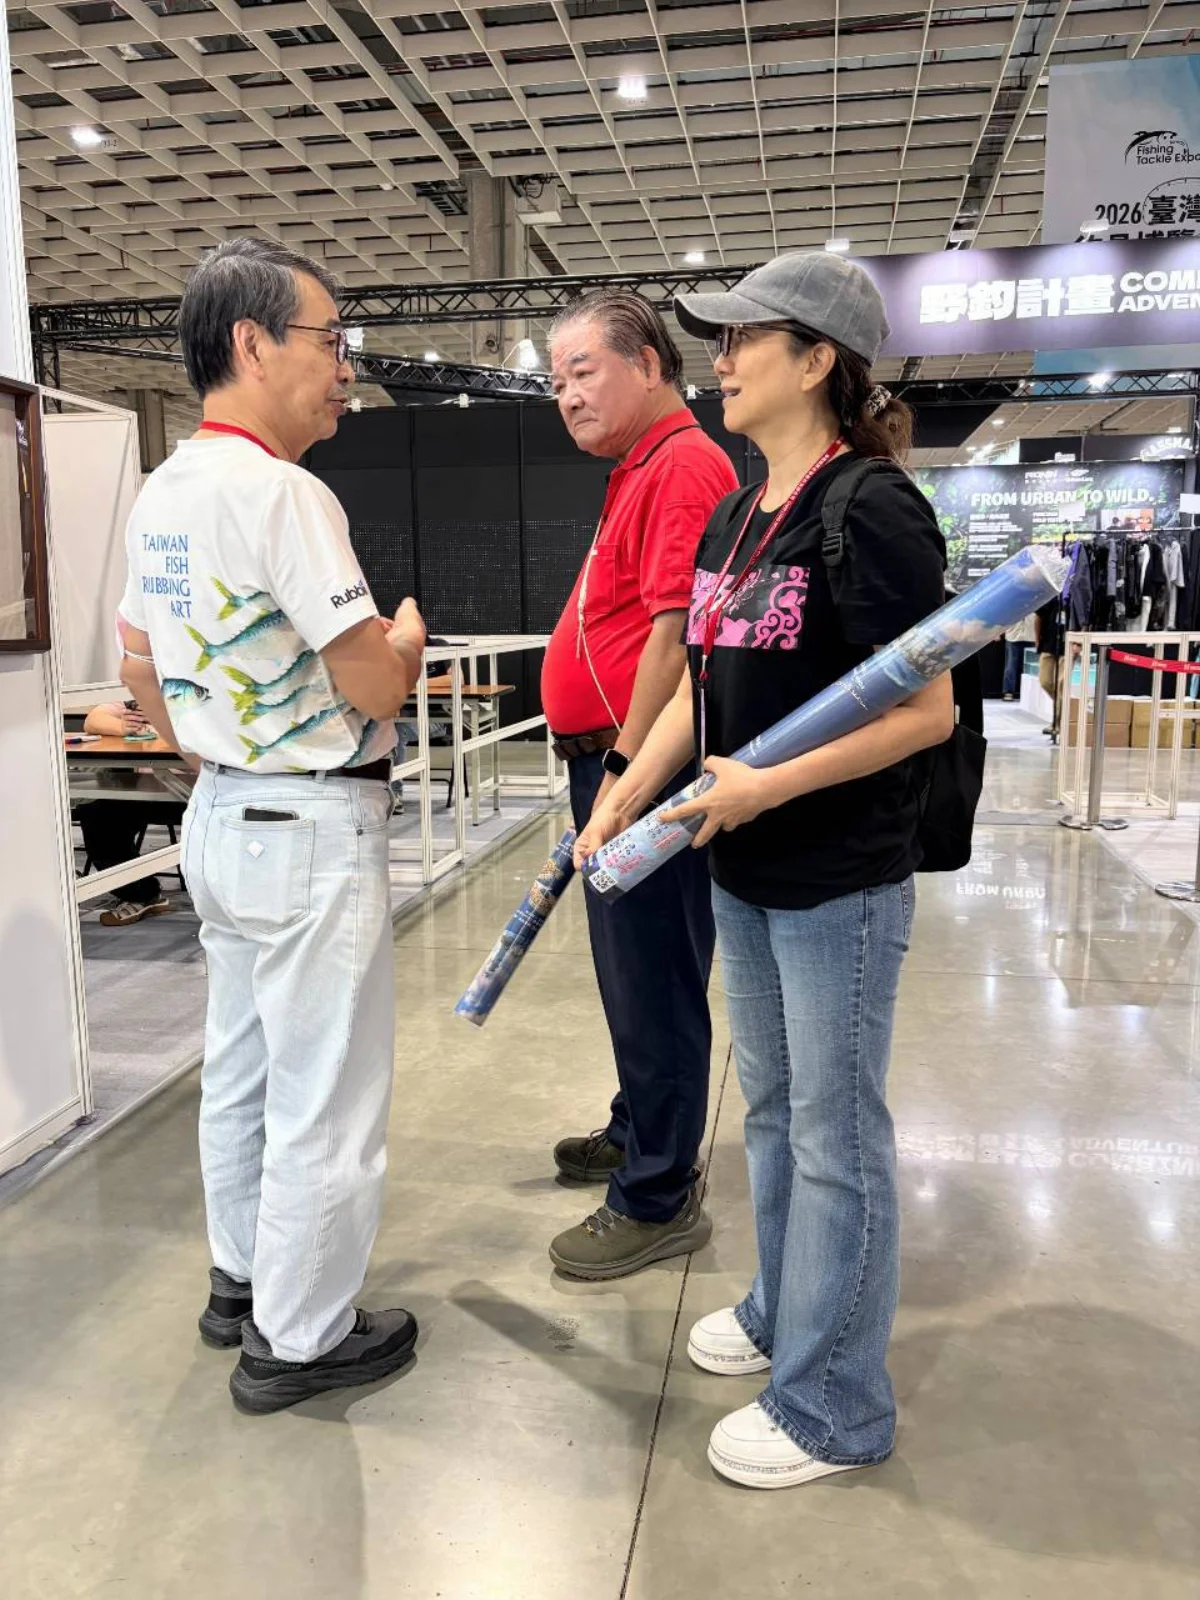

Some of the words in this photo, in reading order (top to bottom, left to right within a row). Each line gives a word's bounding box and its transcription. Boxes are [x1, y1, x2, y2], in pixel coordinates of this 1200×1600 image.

[1137, 145, 1174, 155] Fishing
[1137, 155, 1172, 165] Tackle
[1095, 202, 1141, 225] 2026
[1120, 270, 1200, 293] COM
[971, 492, 1017, 506] FROM
[1021, 490, 1077, 505] URBAN
[1082, 490, 1100, 504] TO
[142, 534, 188, 552] TAIWAN
[165, 556, 189, 574] FISH
[142, 576, 190, 597] RUBBING
[170, 600, 192, 618] ART
